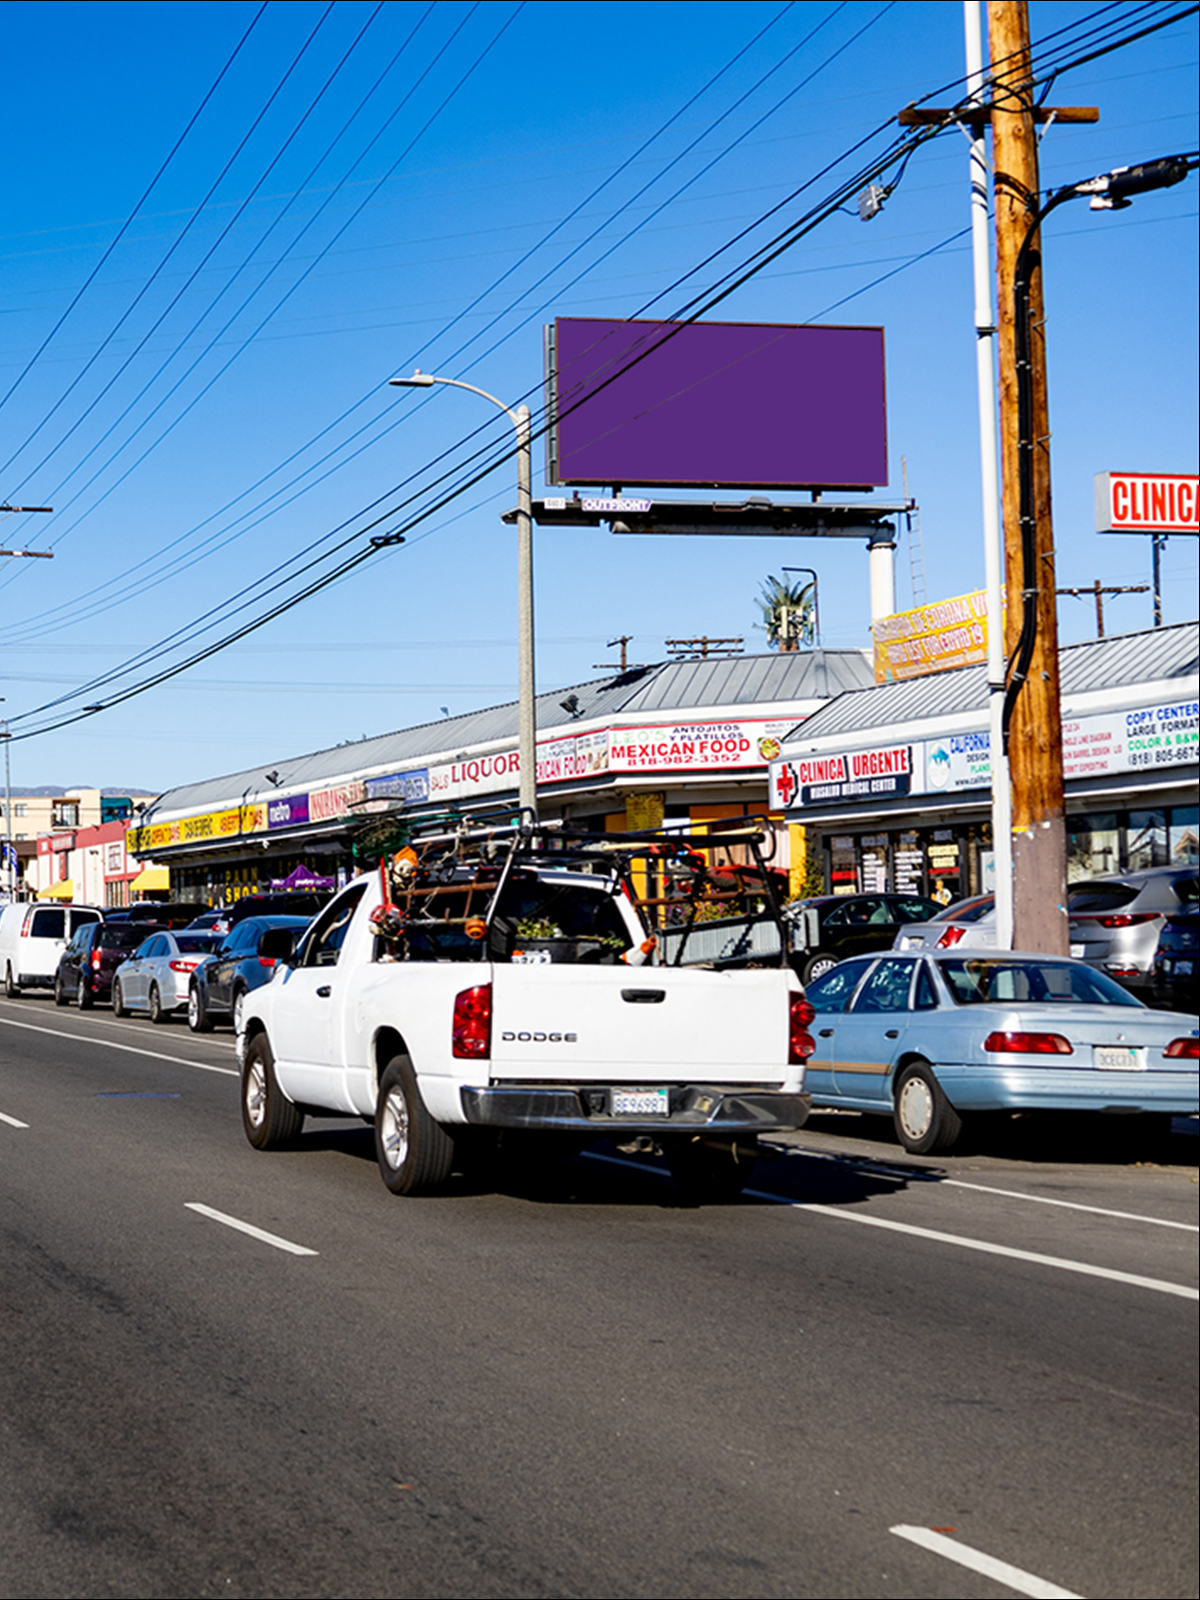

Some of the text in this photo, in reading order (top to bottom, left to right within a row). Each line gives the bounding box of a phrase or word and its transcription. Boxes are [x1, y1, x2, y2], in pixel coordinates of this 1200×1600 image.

[1112, 480, 1199, 523] CLINIC
[924, 598, 973, 630] CORONA
[921, 633, 944, 657] FOR
[939, 627, 972, 652] COVID
[969, 624, 985, 646] 19
[1125, 702, 1199, 726] COPY CENTER
[612, 730, 667, 745] LEO'S
[673, 724, 740, 734] ANTOJITOS
[680, 732, 745, 742] PLATILLOS
[1127, 717, 1199, 738] LARGE FORMAT
[611, 741, 696, 759] MEXICAN
[700, 738, 751, 755] FOOD
[949, 733, 991, 754] CALIFORNIA
[1127, 737, 1162, 751] COLOR
[1175, 732, 1199, 745] B&W
[451, 752, 520, 784] LIQUOR
[535, 758, 562, 780] EXICAN
[627, 753, 741, 767] 818-982-3352
[799, 748, 908, 784] CLINICA URGENTE
[1128, 751, 1153, 766] (818)
[870, 777, 897, 793] CENTER
[501, 1031, 578, 1043] DODGE
